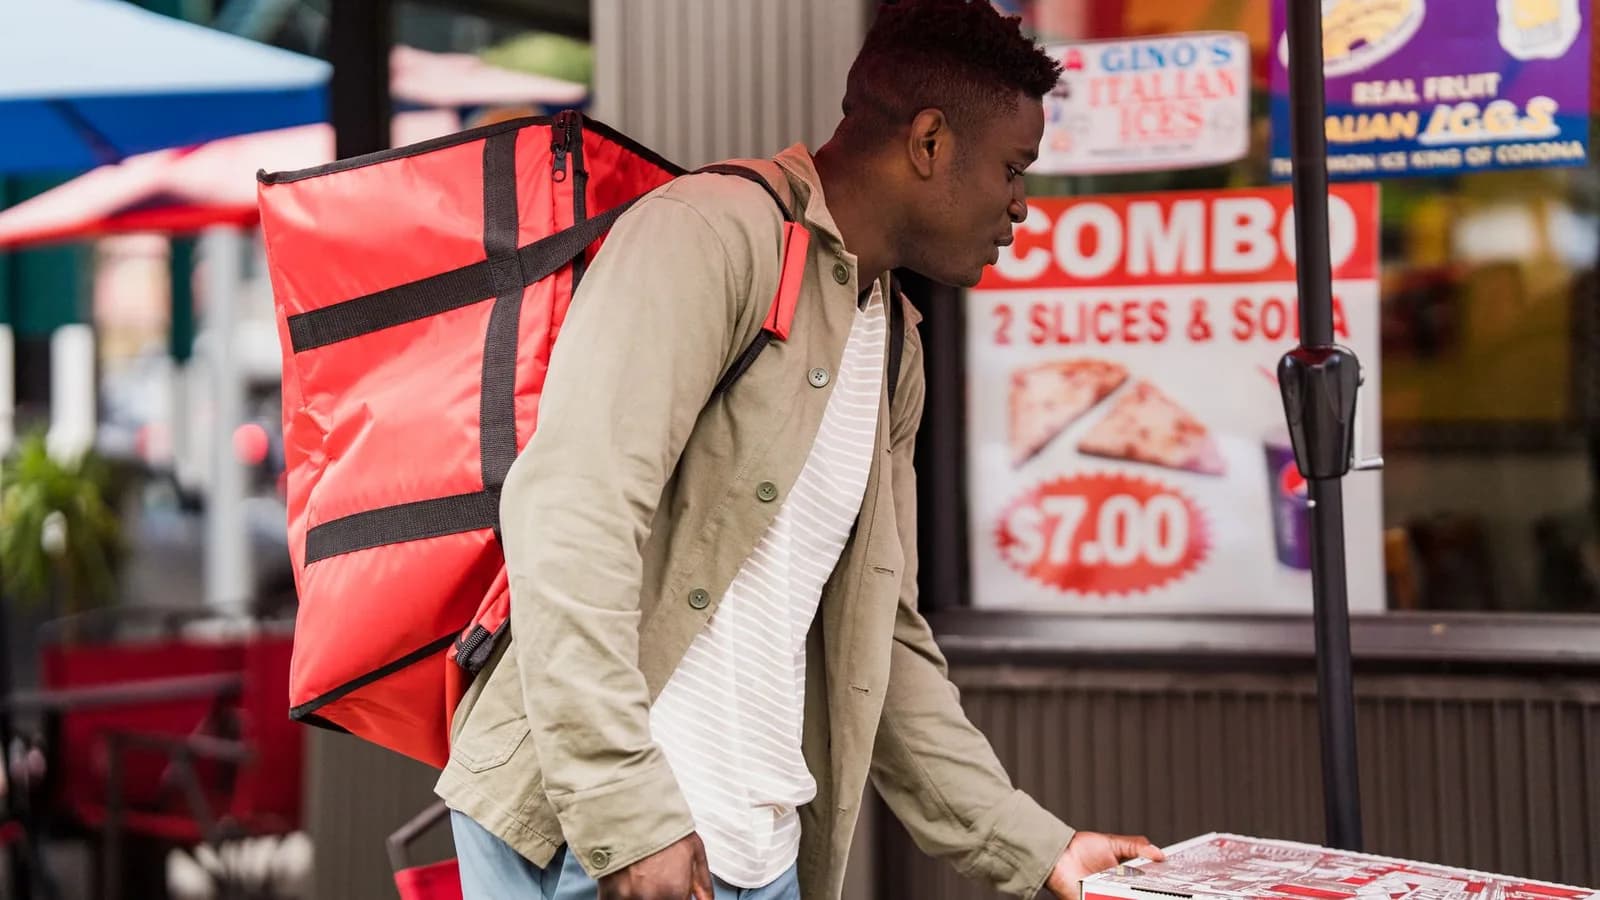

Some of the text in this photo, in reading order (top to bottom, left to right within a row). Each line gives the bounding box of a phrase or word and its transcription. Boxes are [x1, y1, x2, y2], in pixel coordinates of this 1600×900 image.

[1100, 39, 1233, 72] GINO'S
[1089, 69, 1237, 106] ITALIAN
[1353, 72, 1499, 105] REAL FRUIT
[1119, 103, 1205, 142] ICES
[1325, 111, 1418, 142] ALIAN
[1327, 153, 1375, 172] MON
[1464, 147, 1492, 165] OF
[1496, 141, 1585, 164] CORONA
[998, 195, 1357, 281] COMBO
[993, 296, 1349, 344] 2 SLICES & SOA
[1005, 495, 1188, 567] $7.00
